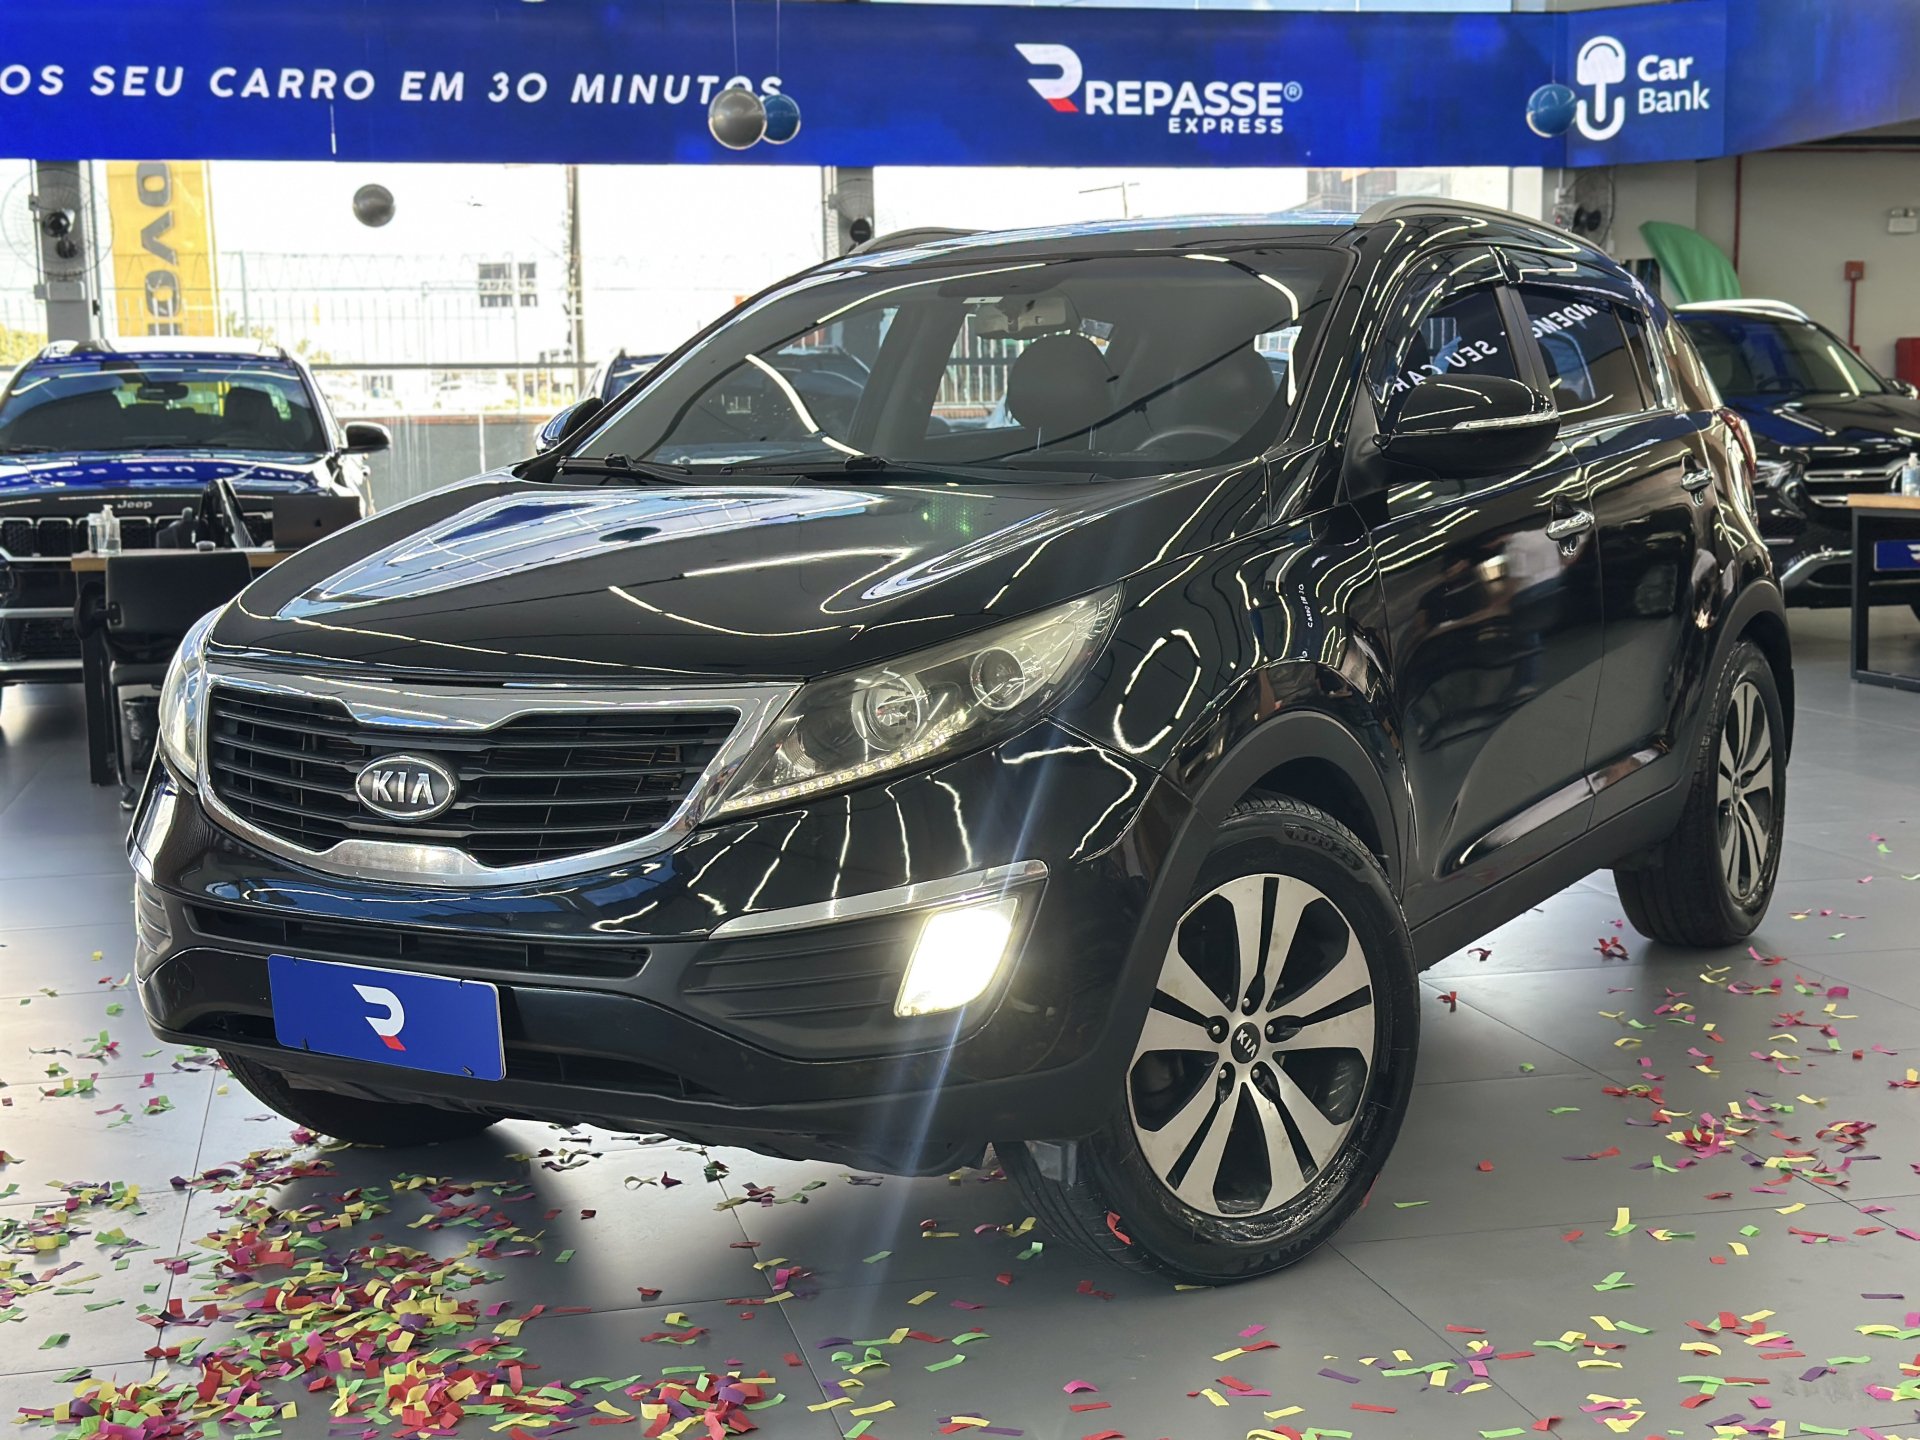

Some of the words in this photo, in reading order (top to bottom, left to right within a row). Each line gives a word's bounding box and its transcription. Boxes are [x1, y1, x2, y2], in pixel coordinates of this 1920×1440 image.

[1637, 54, 1694, 82] Car
[0, 64, 64, 96] OS
[90, 65, 184, 97] SEU
[209, 67, 375, 101] CARRO
[400, 71, 465, 102] EM
[488, 72, 548, 103] 30
[1638, 80, 1710, 114] Bank
[1168, 117, 1284, 134] EXPRESS
[117, 500, 153, 509] Jeep
[371, 769, 435, 806] KIA
[1236, 1028, 1257, 1058] KIA
